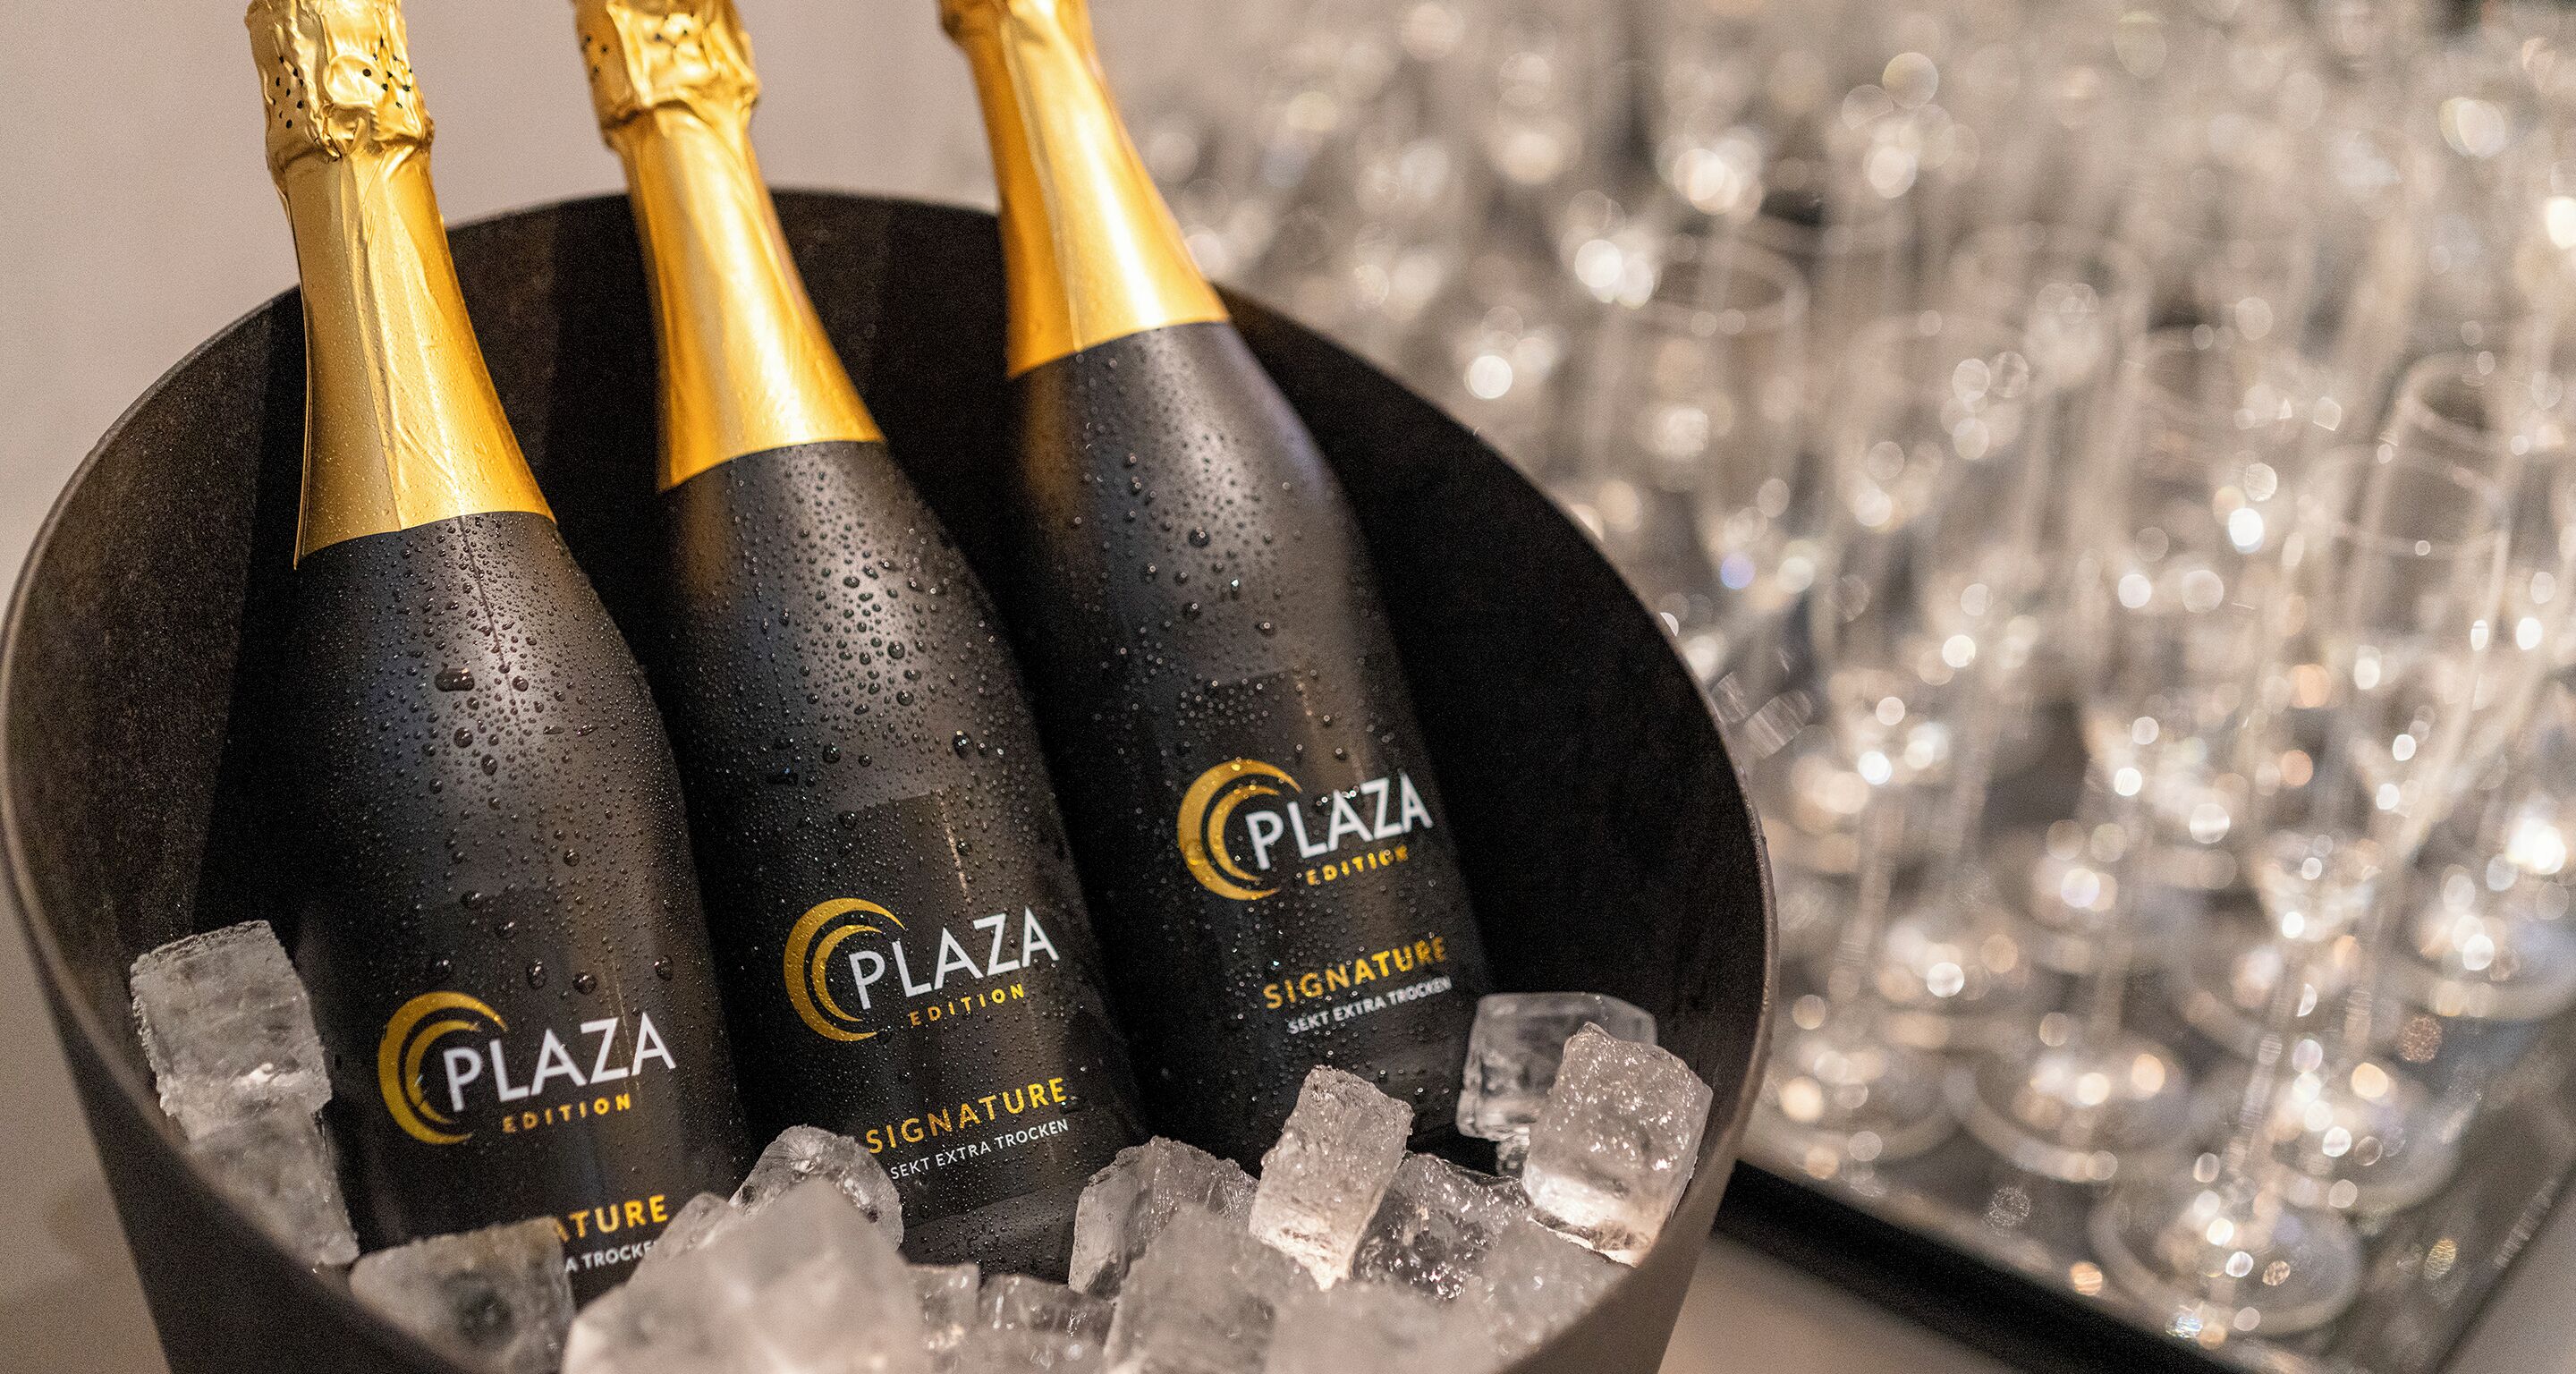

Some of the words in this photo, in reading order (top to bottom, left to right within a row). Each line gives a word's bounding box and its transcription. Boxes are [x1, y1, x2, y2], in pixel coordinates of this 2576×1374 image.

[1245, 768, 1433, 870] PLAZA
[1306, 844, 1409, 886] EDITION
[849, 906, 1060, 1010] PLAZA
[1262, 937, 1446, 1010] SIGNATURE
[909, 983, 1025, 1027] EDITION
[1287, 1010, 1329, 1035] SEKT
[1333, 996, 1386, 1022] EXTRA
[1386, 975, 1453, 1005] TROCKEN
[443, 1012, 676, 1112] PLAZA
[503, 1093, 631, 1134] EDITION
[866, 1077, 1067, 1154] SIGNATURE
[890, 1158, 929, 1180] SEKT
[936, 1141, 992, 1167] EXTRA
[995, 1118, 1069, 1149] TROCKEN
[555, 1194, 668, 1243] TURE
[580, 1240, 656, 1269] TROCKE
